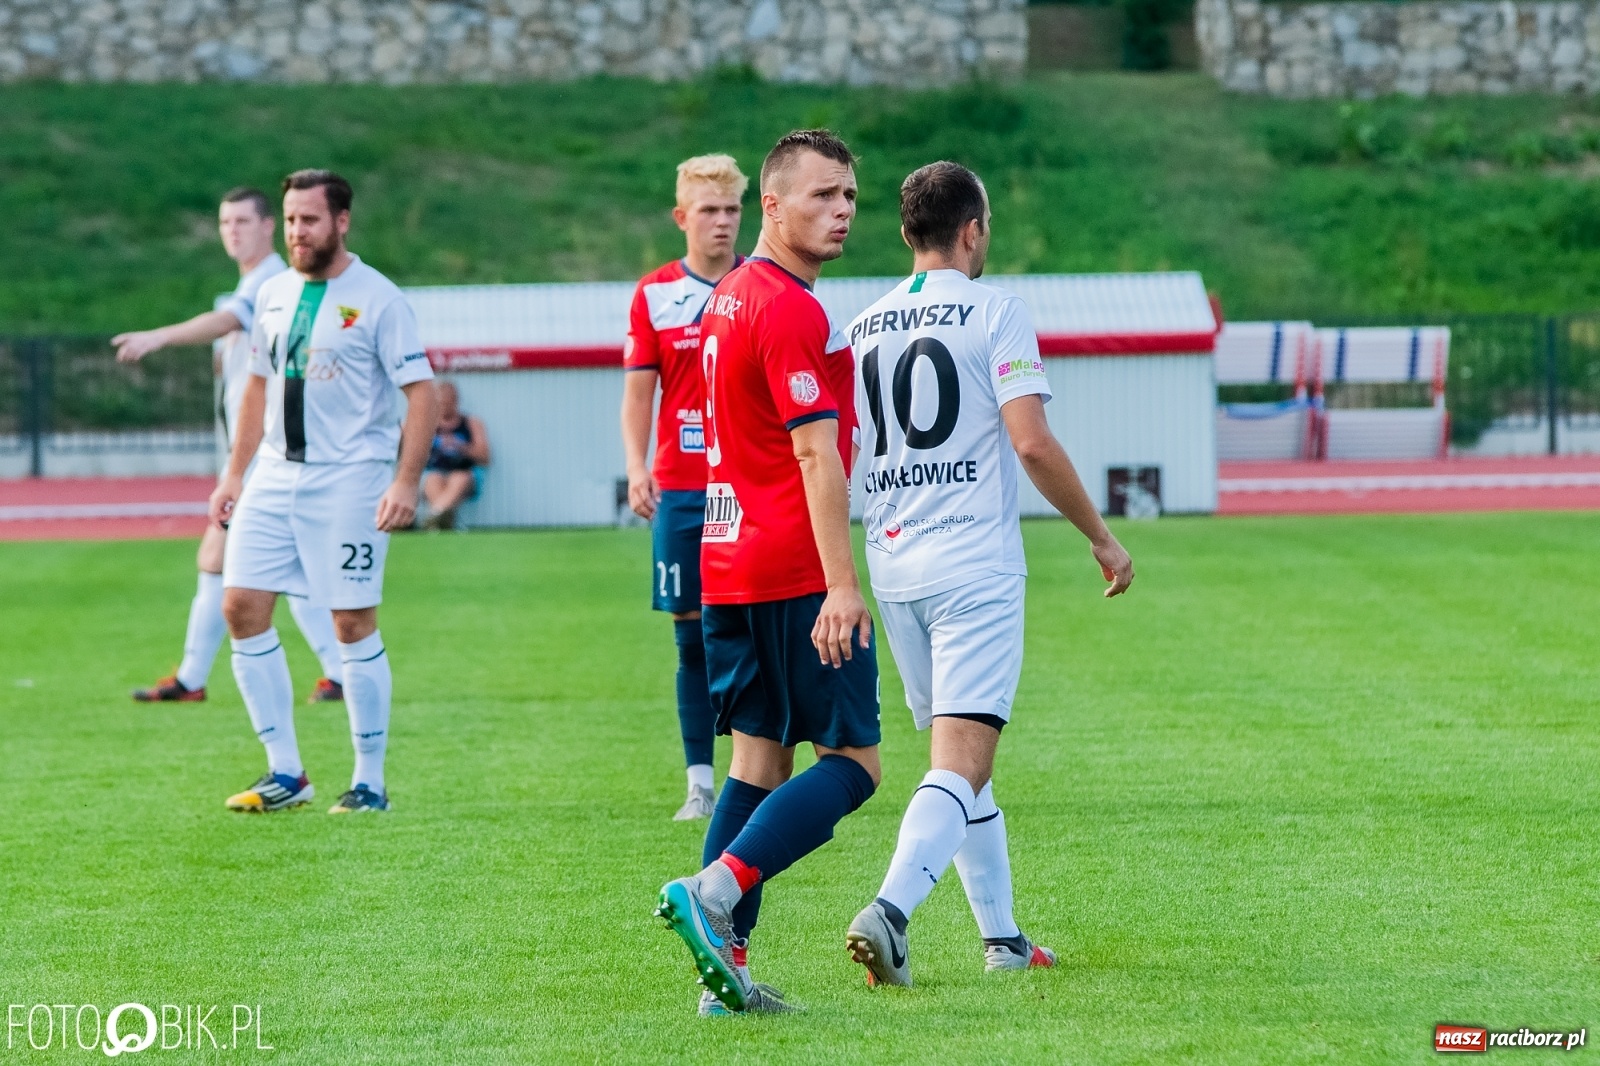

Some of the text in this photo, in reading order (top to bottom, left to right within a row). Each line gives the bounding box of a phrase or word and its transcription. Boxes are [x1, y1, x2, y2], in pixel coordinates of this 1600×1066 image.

[851, 304, 975, 346] PIERWSZY
[862, 337, 960, 457] 10
[683, 431, 704, 446] no
[706, 488, 740, 528] winy
[903, 515, 975, 527] POLSKA GRUPA
[342, 543, 373, 570] 23
